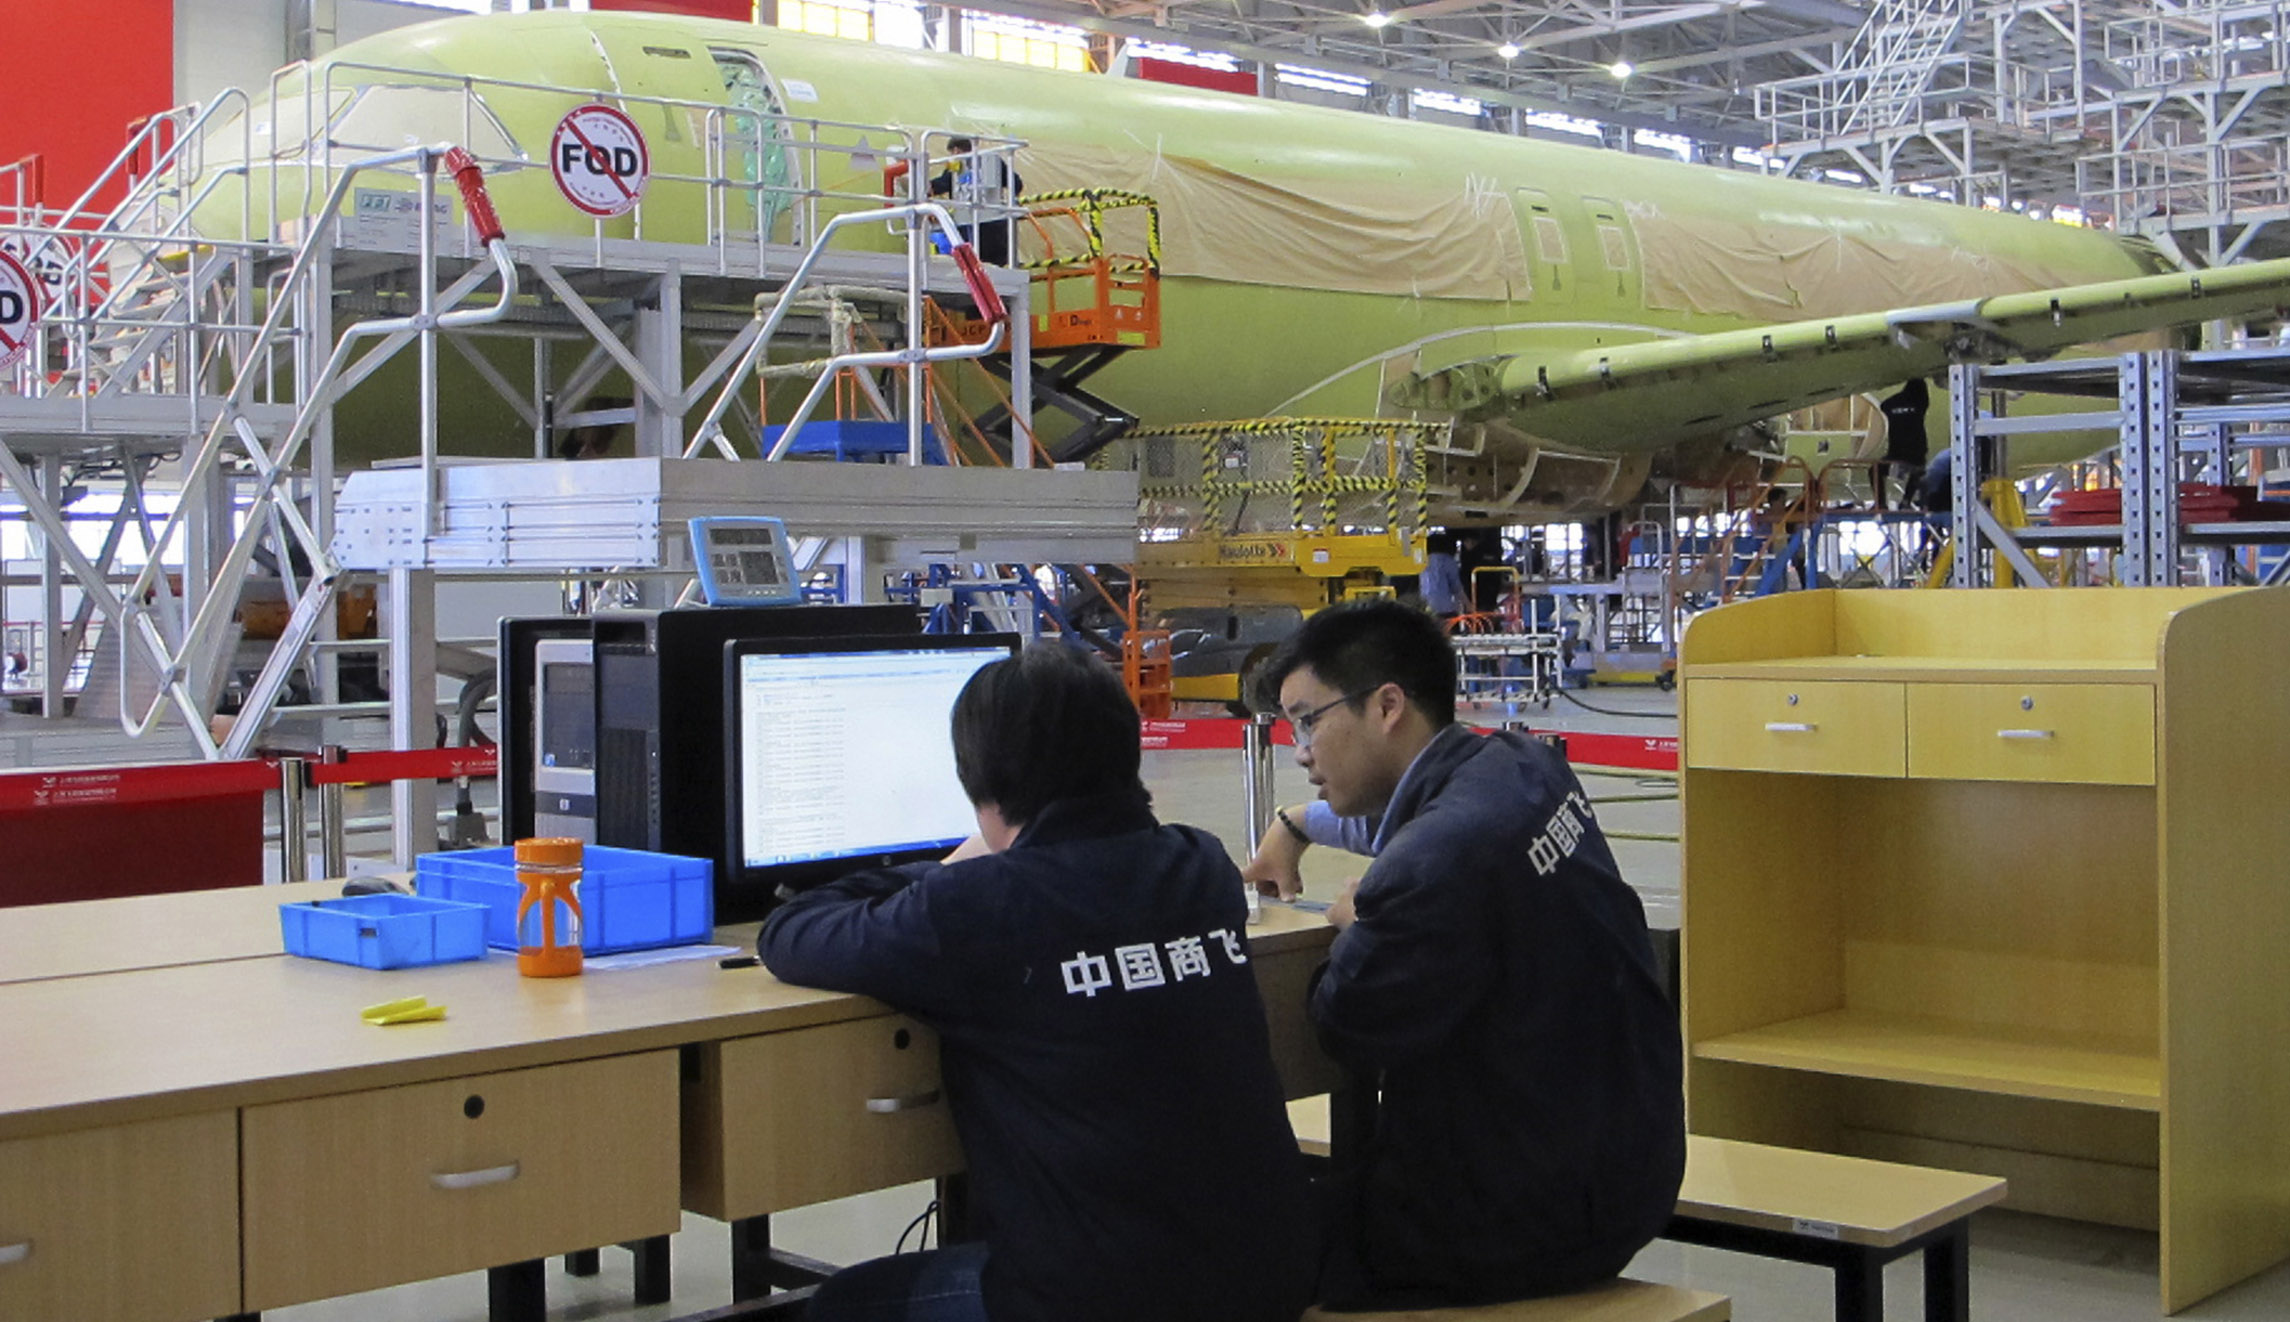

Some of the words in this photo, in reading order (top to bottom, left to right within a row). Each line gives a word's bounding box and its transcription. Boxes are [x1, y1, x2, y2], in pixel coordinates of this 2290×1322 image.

[562, 143, 638, 177] FOD
[1527, 791, 1592, 875] 中国商飞
[1060, 928, 1248, 997] 中国商飞
